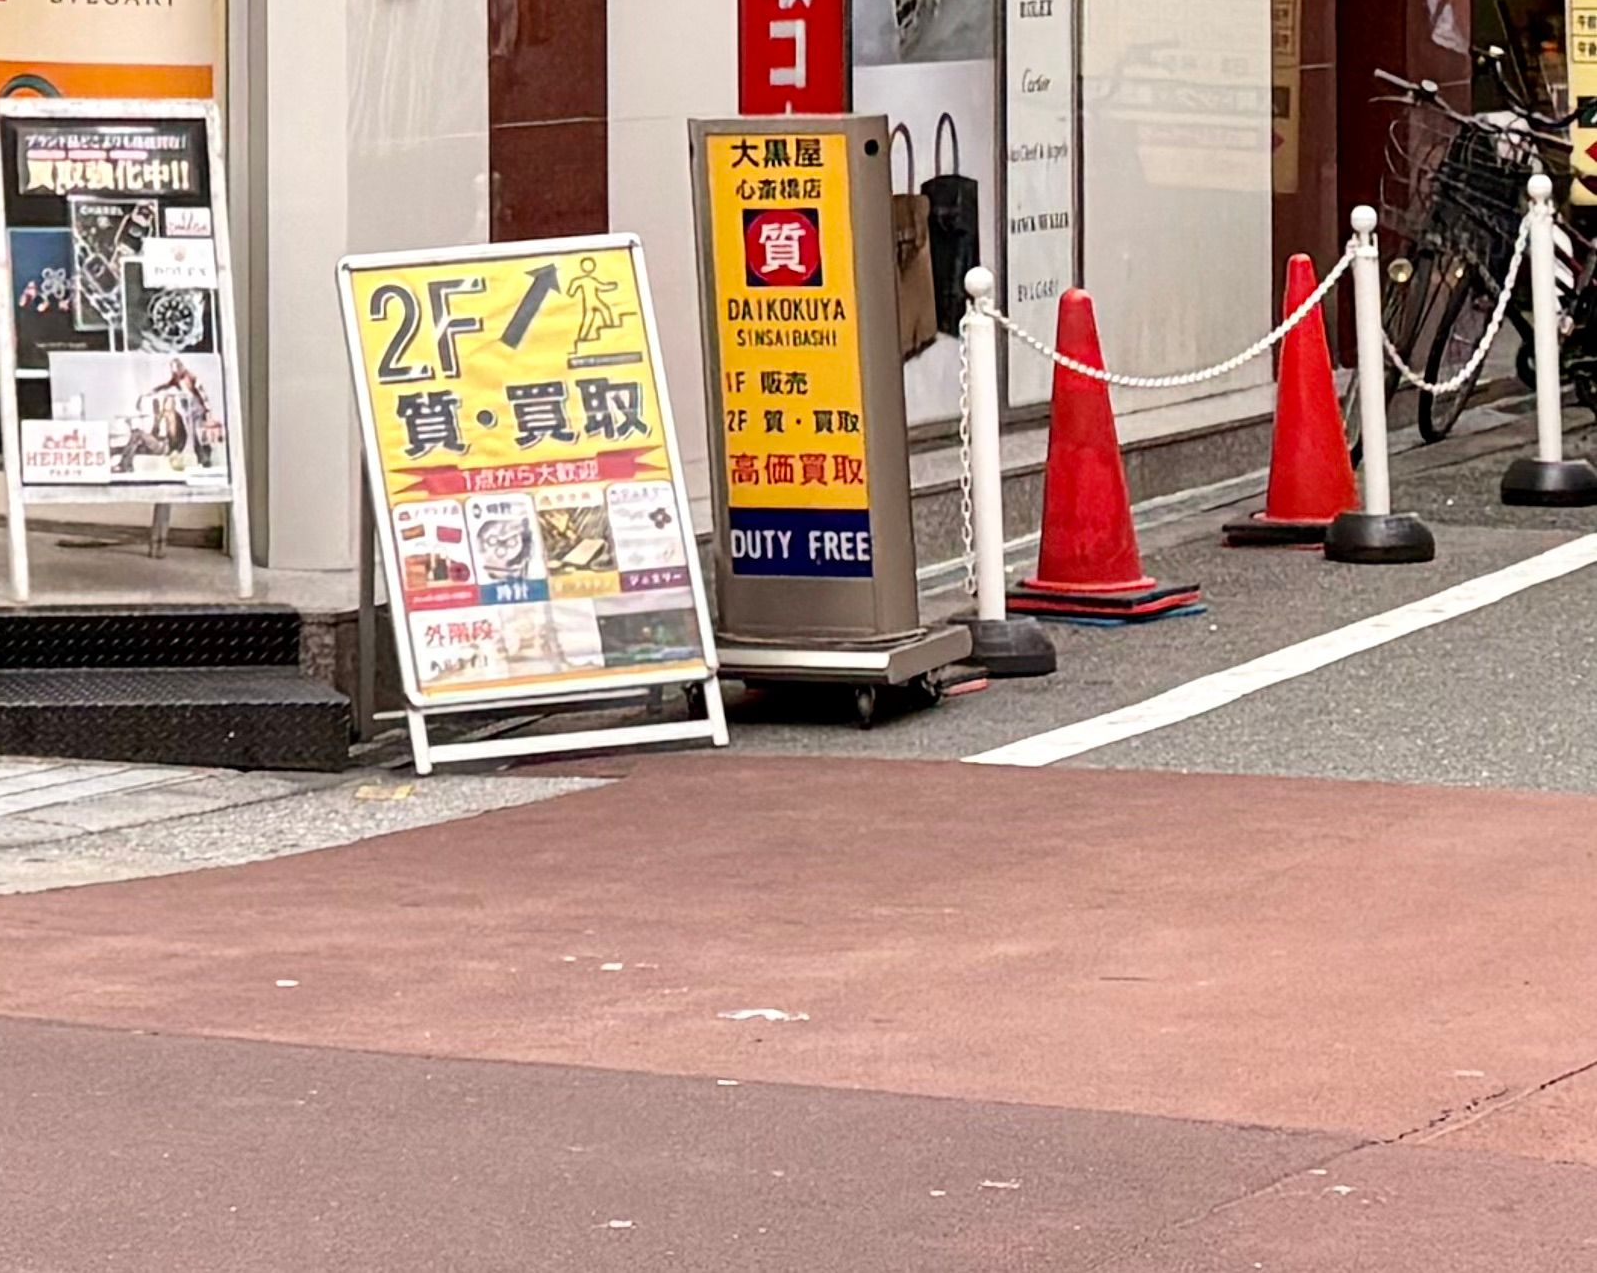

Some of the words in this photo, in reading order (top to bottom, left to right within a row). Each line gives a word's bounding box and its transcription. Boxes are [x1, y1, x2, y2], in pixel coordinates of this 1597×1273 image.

[731, 138, 824, 168] 大黒屋
[736, 178, 822, 201] 心斎橋店
[759, 222, 806, 273] 質
[728, 298, 846, 321] DAIKOKUYA
[369, 277, 487, 385] 2F
[737, 329, 837, 347] SINSAIBASHI
[726, 371, 745, 394] 1F
[760, 371, 808, 395] 販売
[727, 410, 747, 432] 2F
[462, 460, 601, 490] 1点から大歓迎
[729, 452, 864, 486] 高価買取
[731, 529, 792, 559] DUTY
[808, 530, 871, 561] FREE
